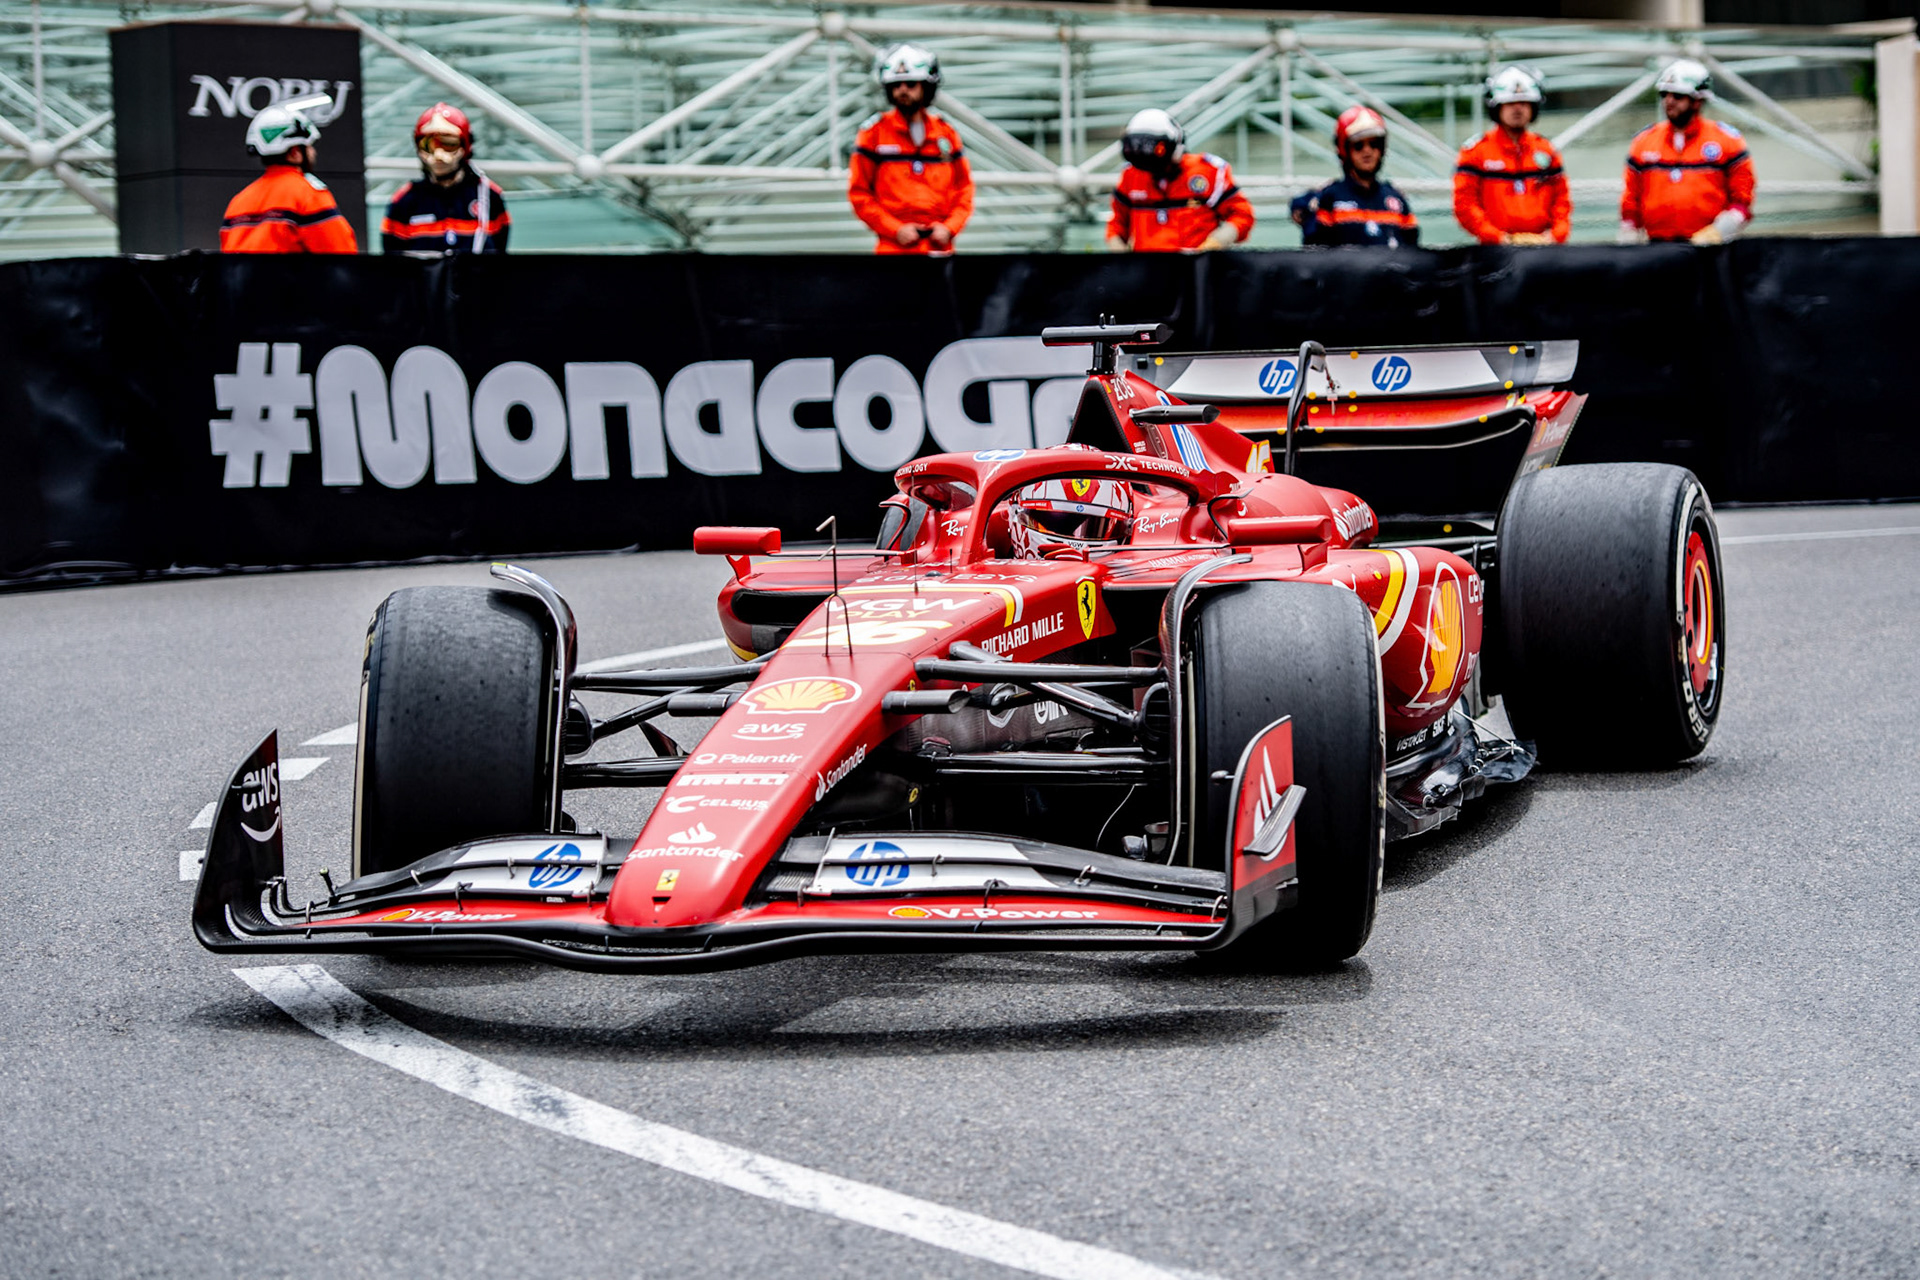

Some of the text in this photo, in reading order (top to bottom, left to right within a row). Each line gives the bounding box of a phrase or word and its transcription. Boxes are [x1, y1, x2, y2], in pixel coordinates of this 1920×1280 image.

[1261, 359, 1298, 395] hp
[1374, 356, 1409, 392] hp
[1103, 454, 1190, 478] DXC TECHNOLOGY
[883, 573, 1037, 582] GEESYS
[823, 598, 982, 612] VGW
[837, 610, 931, 619] PLAY
[981, 612, 1065, 656] RICHARD MILLE
[737, 722, 808, 734] aws
[718, 752, 803, 764] Palantir
[825, 743, 868, 793] Santander
[675, 773, 790, 786] PIRELLI
[242, 762, 279, 813] aws
[698, 798, 770, 809] CELSIUS
[848, 841, 908, 887] hp
[404, 910, 517, 921] V-Power
[930, 907, 1099, 919] V-Power
